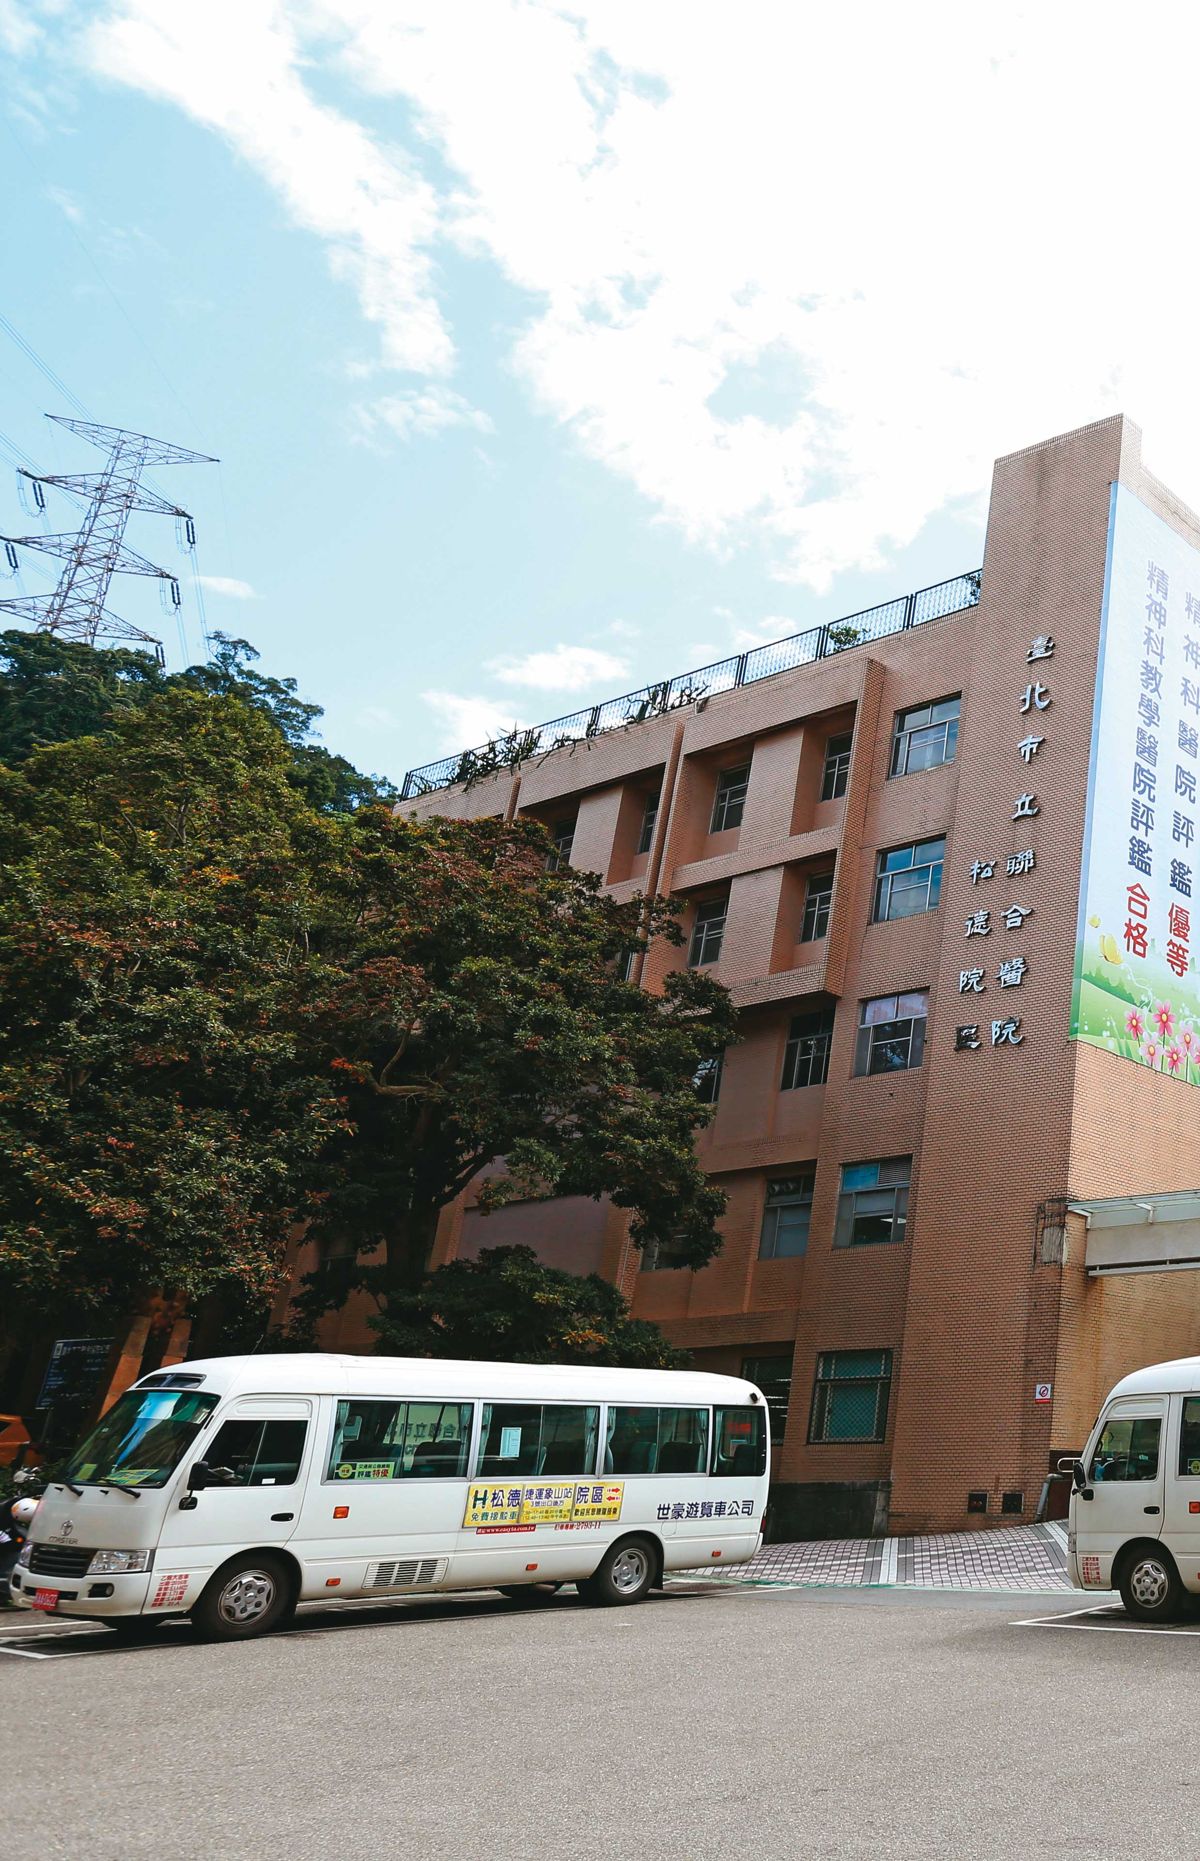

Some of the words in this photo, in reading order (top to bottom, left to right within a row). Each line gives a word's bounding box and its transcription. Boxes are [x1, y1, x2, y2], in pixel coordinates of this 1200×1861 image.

[1123, 559, 1170, 959] 精神科教學醫院評鑑合格
[524, 1487, 573, 1500] 捷運象山站
[470, 1510, 519, 1522] 免費接駁車
[656, 1500, 754, 1520] 世豪遊覽車公司
